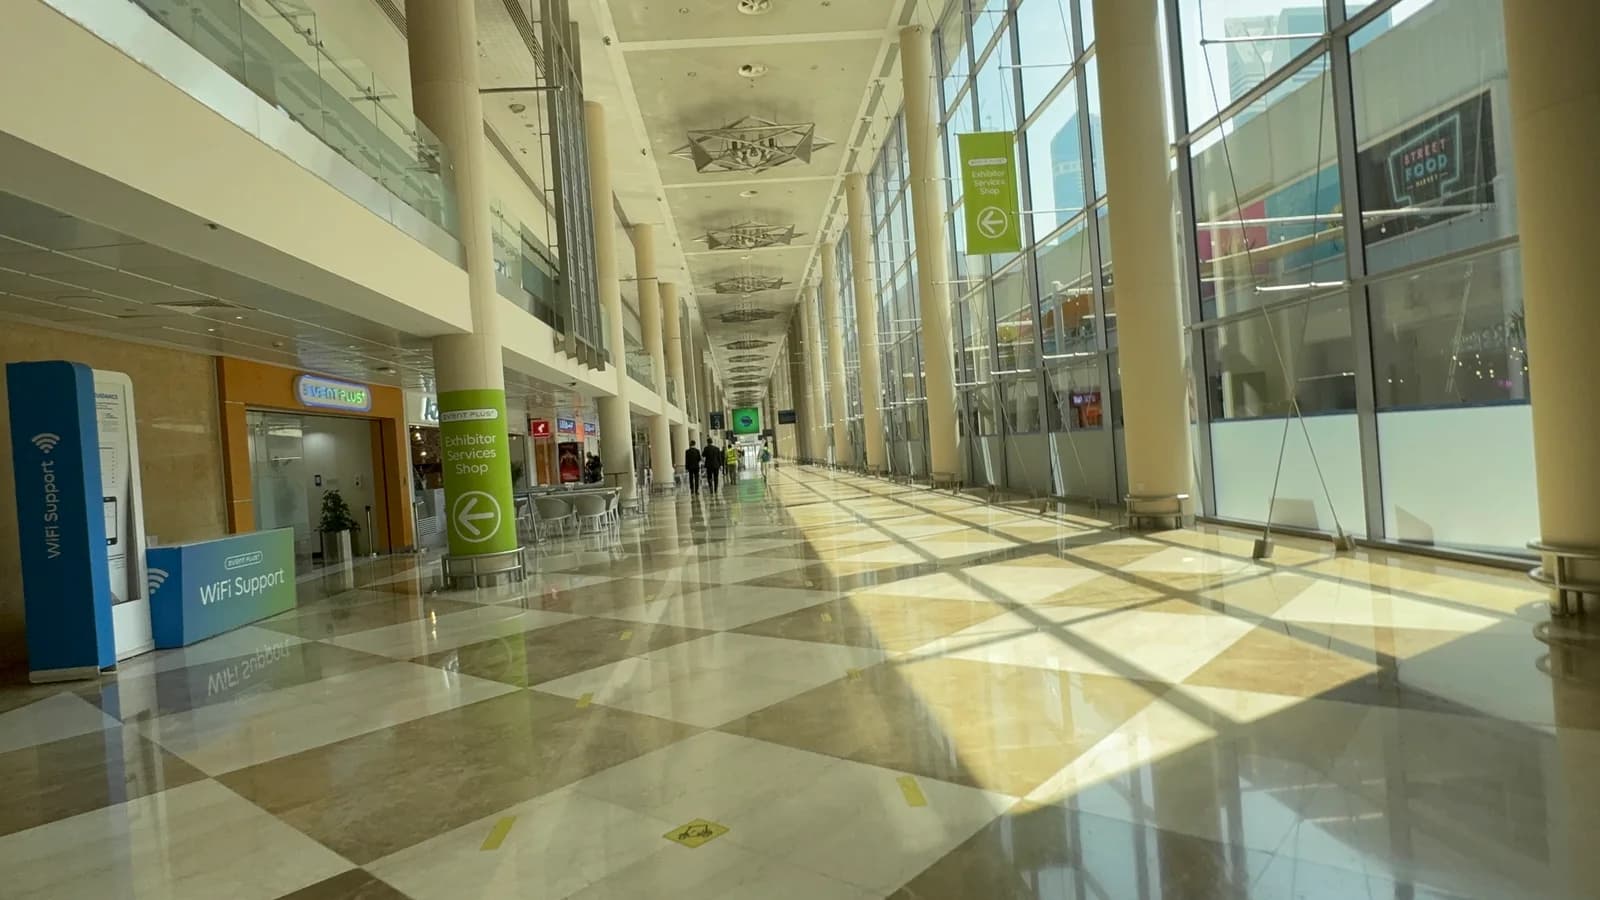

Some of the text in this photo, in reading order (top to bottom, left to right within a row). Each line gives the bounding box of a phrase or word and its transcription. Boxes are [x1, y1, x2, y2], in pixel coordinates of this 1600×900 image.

[1404, 138, 1446, 166] STREET
[1405, 154, 1448, 182] FOOD
[445, 434, 497, 448] Exhibitor
[447, 448, 497, 462] Services
[456, 463, 489, 476] Shop
[41, 460, 62, 560] WiFi Support
[199, 568, 285, 606] WiFi Support
